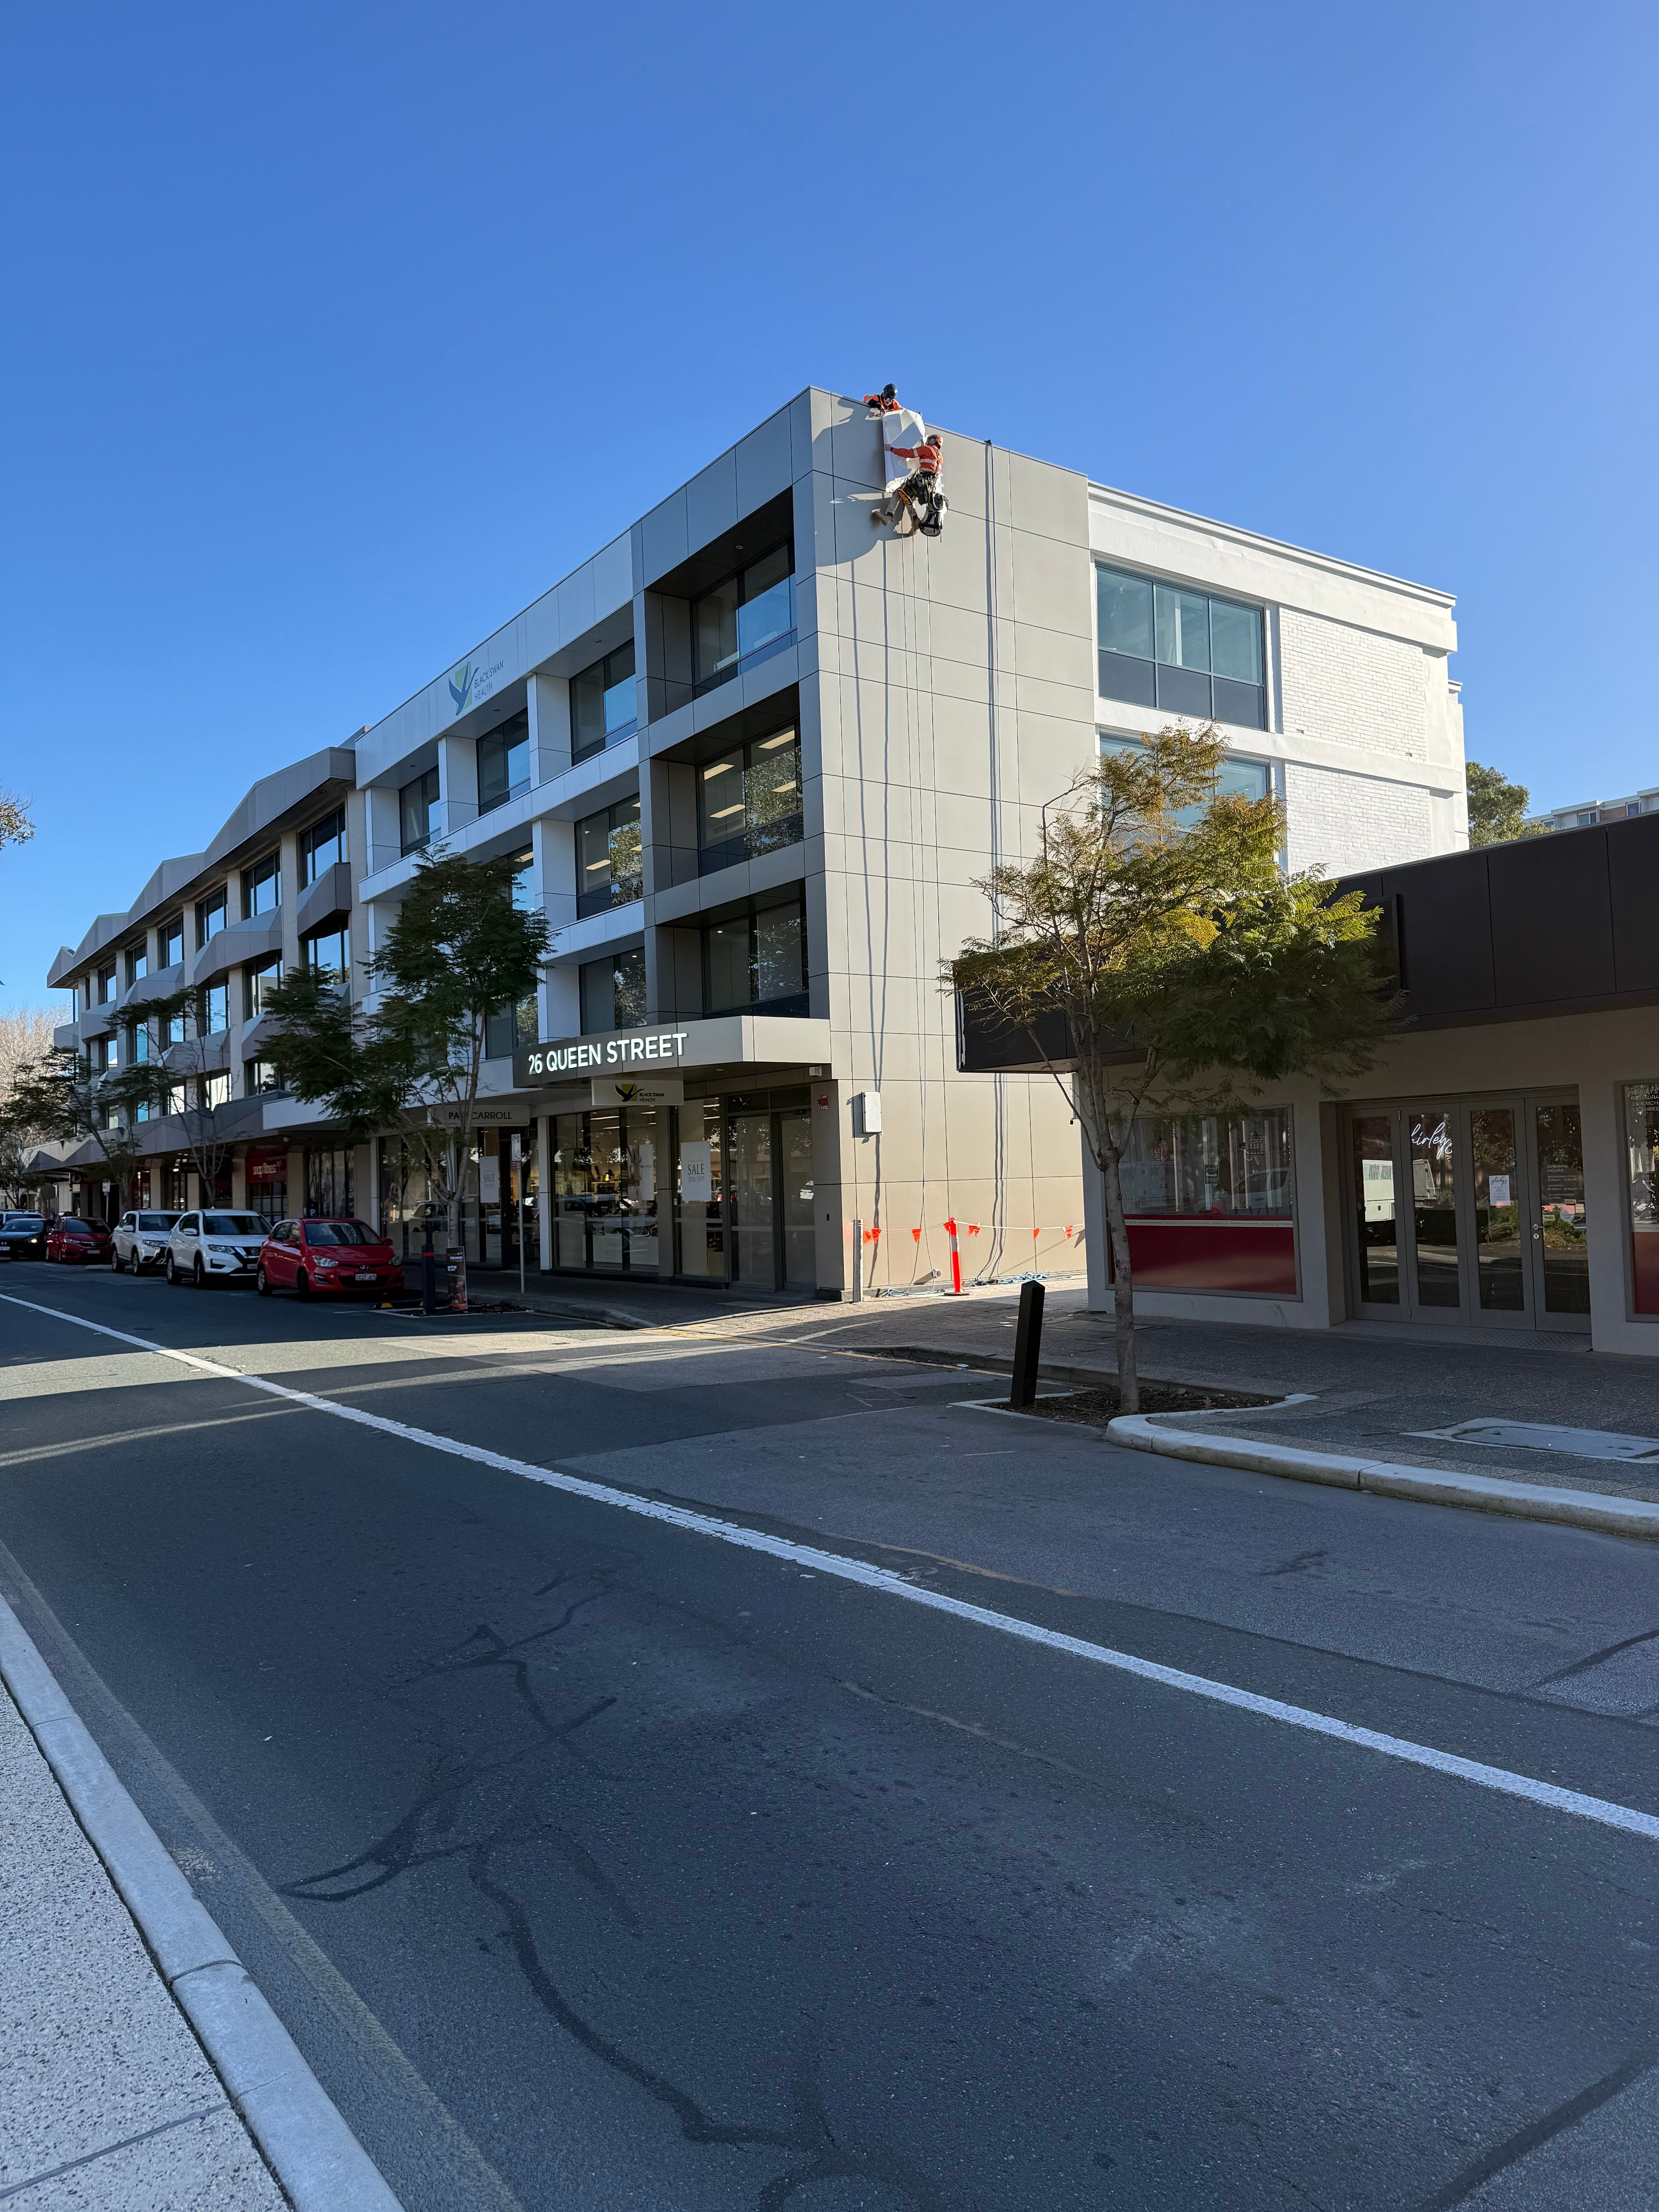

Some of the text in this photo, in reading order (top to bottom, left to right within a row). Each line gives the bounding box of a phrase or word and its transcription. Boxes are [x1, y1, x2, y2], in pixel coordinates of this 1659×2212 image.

[474, 659, 503, 688] BLACK SWAN
[474, 681, 492, 702] HEALTH
[528, 1033, 688, 1075] 26 QUEEN STREET
[253, 1166, 263, 1178] snap
[263, 1162, 276, 1174] fitness
[483, 1174, 495, 1183] SALE
[688, 1164, 704, 1175] SALE
